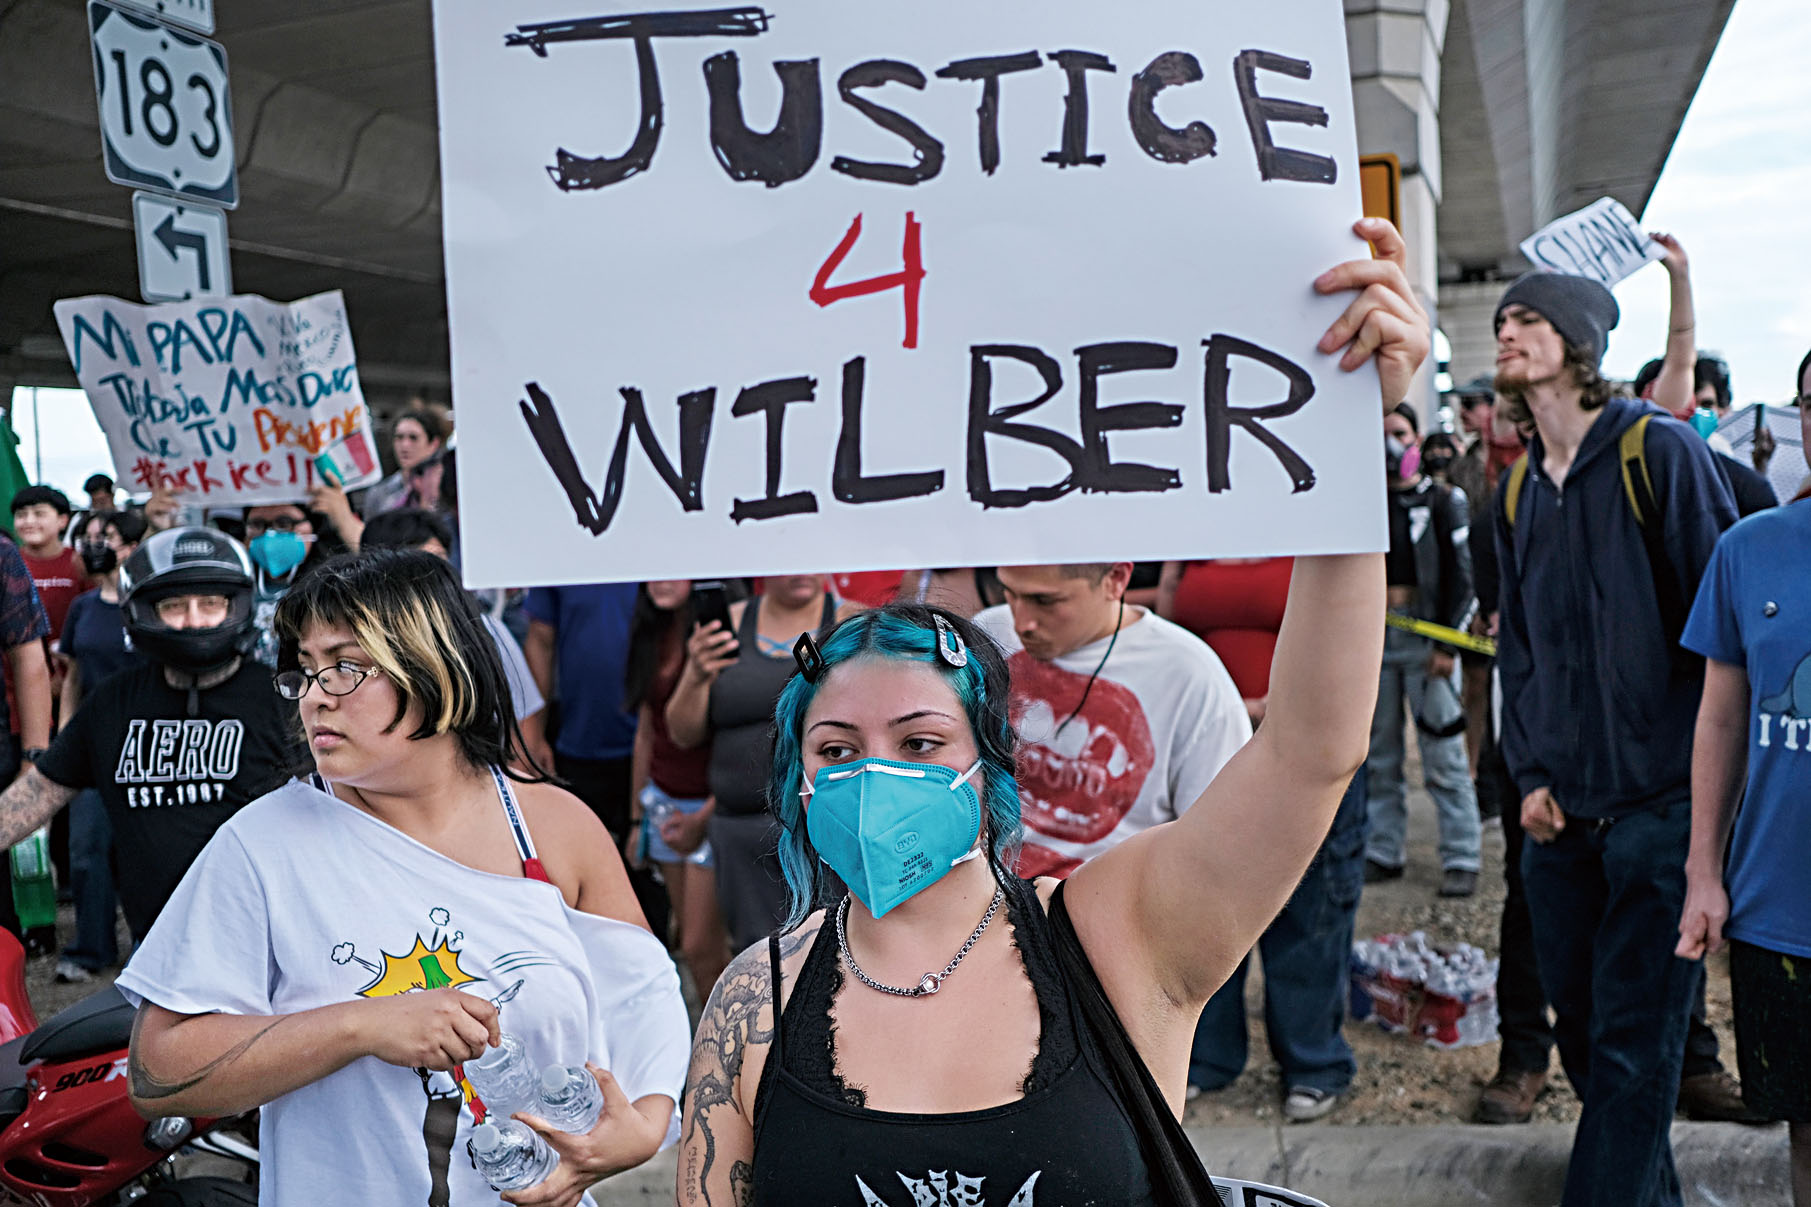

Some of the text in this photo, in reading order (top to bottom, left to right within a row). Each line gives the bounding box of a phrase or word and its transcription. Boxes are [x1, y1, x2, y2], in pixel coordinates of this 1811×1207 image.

[111, 49, 220, 158] 183
[503, 6, 1338, 192] JUSTICE
[808, 211, 927, 350] 4
[146, 307, 265, 375] PAPA
[519, 333, 1316, 537] WILBER
[115, 719, 244, 784] AERO
[1780, 714, 1811, 752] T
[898, 871, 916, 884] NIOSH
